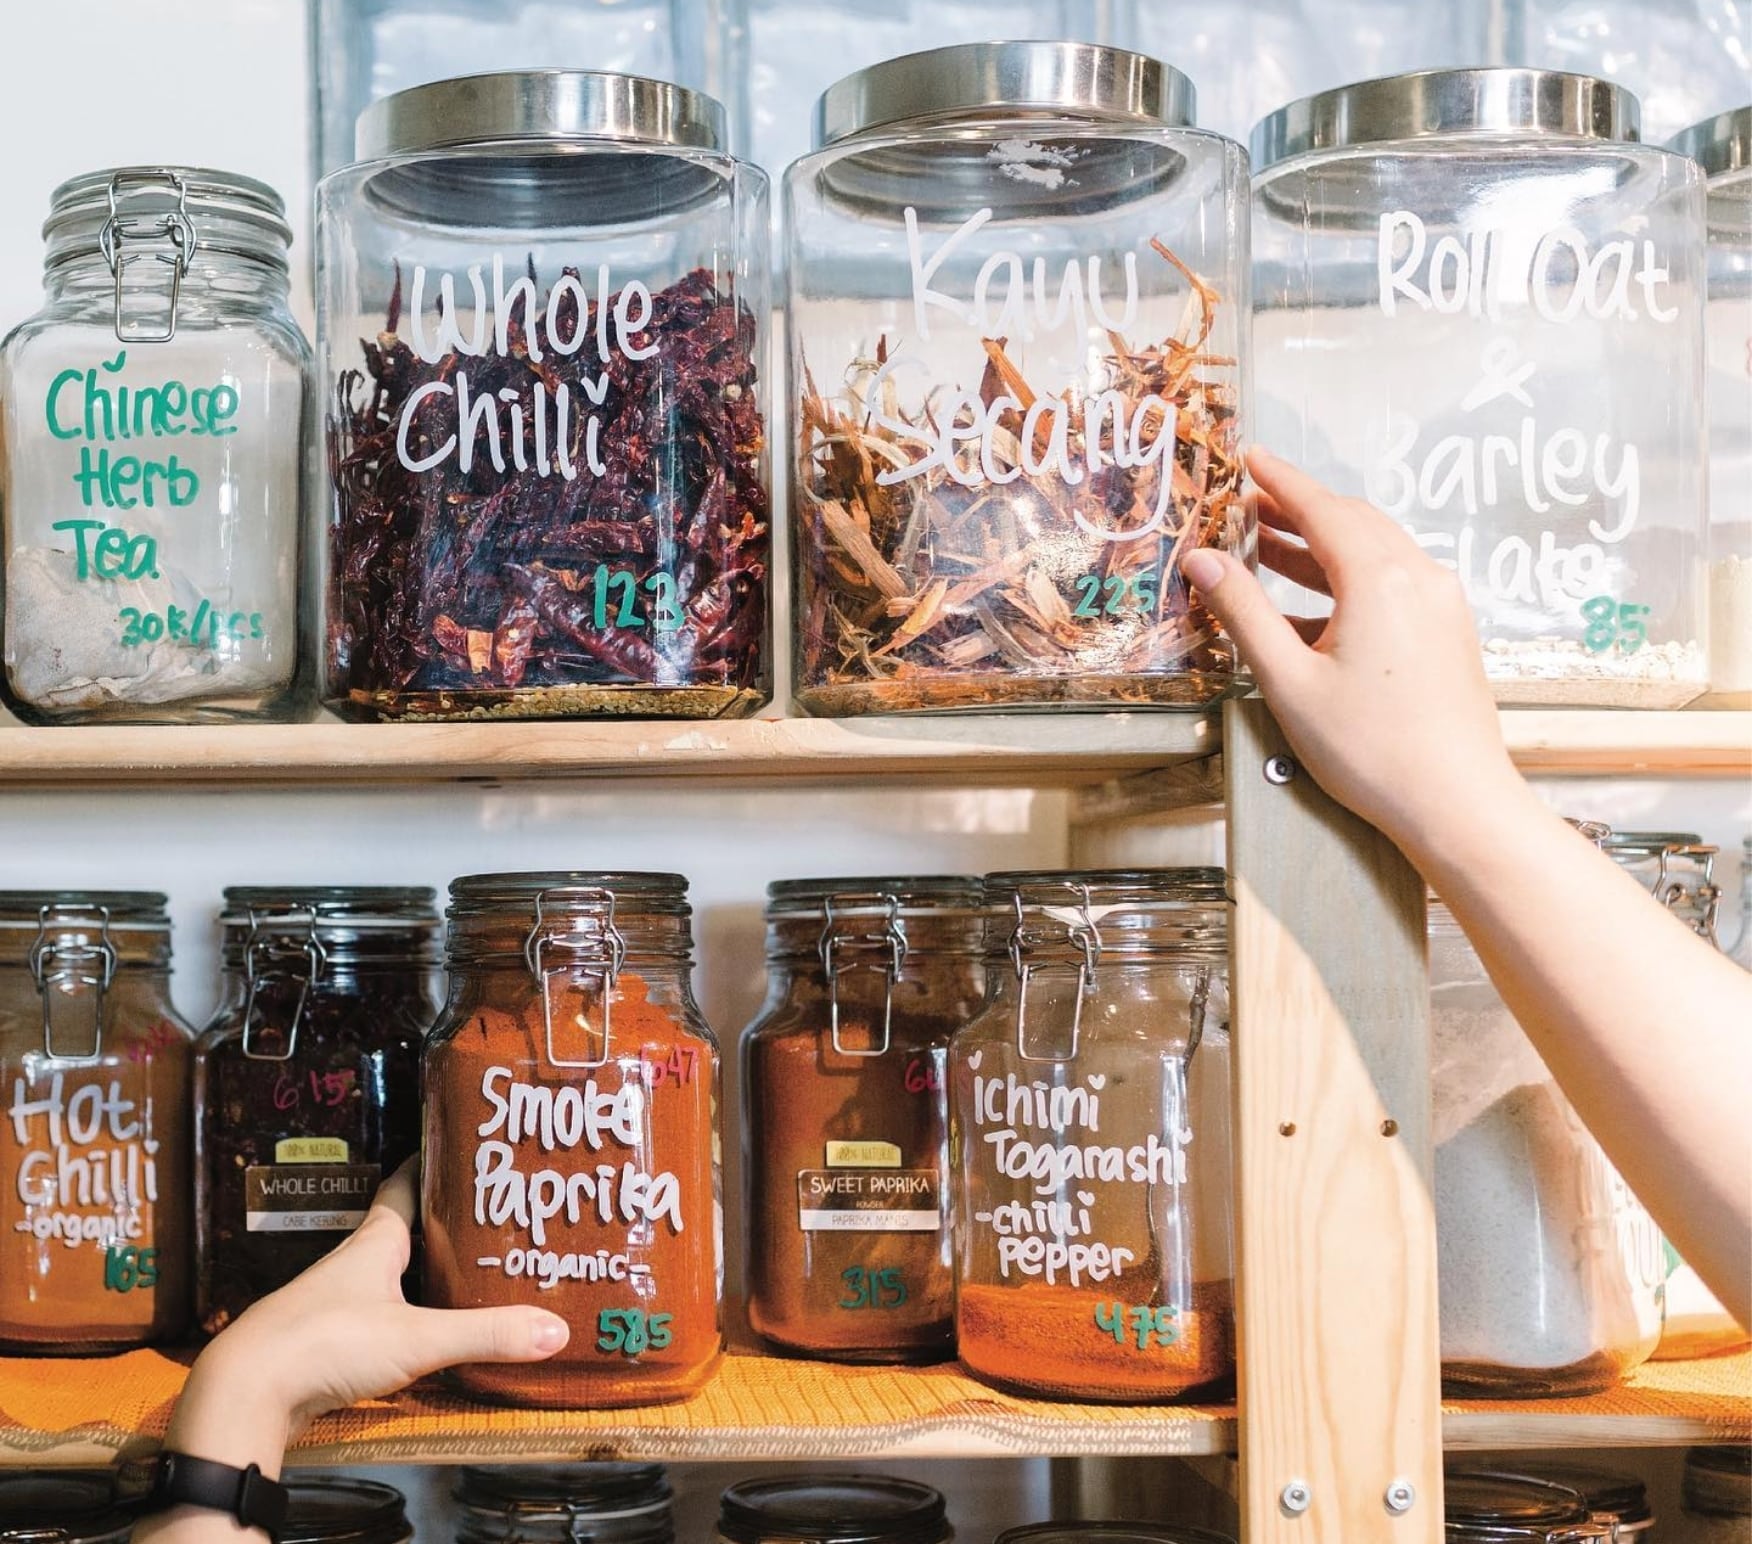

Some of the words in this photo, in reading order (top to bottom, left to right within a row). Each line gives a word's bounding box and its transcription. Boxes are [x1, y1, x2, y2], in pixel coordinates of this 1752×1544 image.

[410, 252, 661, 365] Whole
[904, 206, 1137, 376] Kayu
[1530, 225, 1679, 323] Oat
[45, 351, 239, 441] Chinese
[396, 370, 607, 482] Chilli
[73, 446, 200, 509] Herb
[868, 356, 1177, 542] Secang
[1364, 412, 1640, 544] Barley
[52, 519, 161, 581] Tea
[592, 563, 686, 632] 123
[1075, 573, 1158, 618] 225
[1580, 595, 1651, 655] 85
[8, 1072, 140, 1148] Hot
[477, 1065, 646, 1151] Smoke
[260, 1176, 317, 1196] WHOLE
[320, 1176, 369, 1195] CHILLI
[474, 1140, 685, 1247] Paprika
[810, 1175, 865, 1195] SWEET
[869, 1175, 931, 1195] PAPRIKA
[983, 1126, 1195, 1196] Togarashi
[103, 1244, 161, 1293] 165
[839, 1264, 908, 1310] 315
[597, 1307, 676, 1354] 585
[1094, 1301, 1183, 1350] 475
